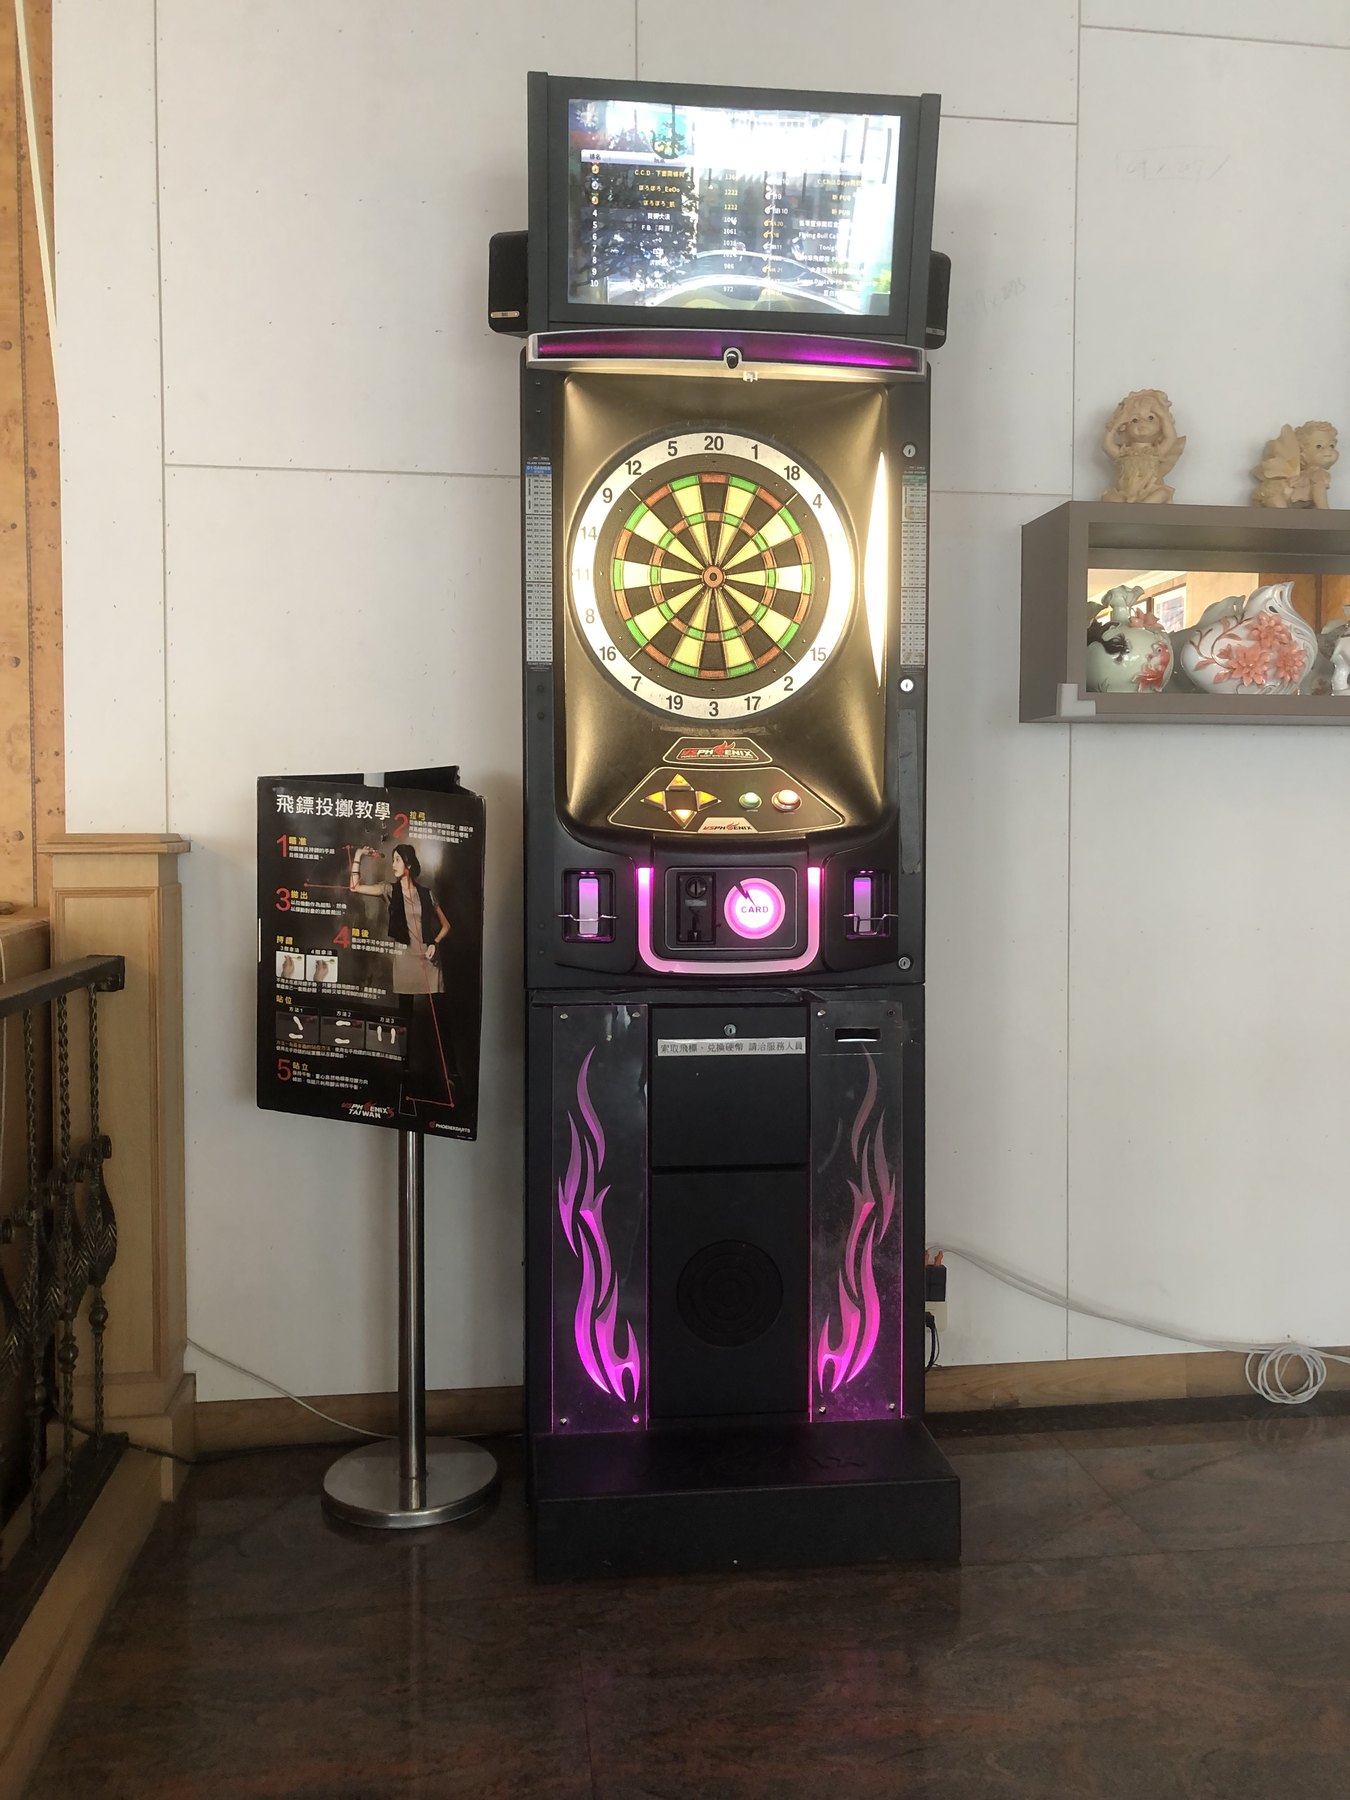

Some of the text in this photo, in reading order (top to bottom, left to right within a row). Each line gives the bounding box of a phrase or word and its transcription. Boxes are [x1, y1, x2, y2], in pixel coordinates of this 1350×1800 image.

[667, 441, 678, 457] 5
[704, 436, 724, 451] 20
[751, 445, 758, 460] 1
[625, 460, 642, 476] 12
[784, 465, 800, 481] 18
[602, 488, 613, 503] 9
[812, 494, 823, 508] 4
[581, 526, 597, 541] 14
[585, 609, 595, 624] 8
[599, 646, 616, 661] 16
[810, 647, 827, 661] 15
[631, 676, 642, 691] 7
[783, 676, 794, 691] 2
[666, 695, 684, 710] 19
[709, 701, 719, 716] 3
[744, 695, 762, 711] 17
[276, 794, 391, 820] 飛鏢投擲教學
[392, 813, 408, 838] 2
[276, 834, 288, 858] 1
[275, 887, 291, 912] 3
[741, 905, 769, 913] CARD
[333, 926, 350, 949] 4
[276, 1058, 292, 1081] 5
[348, 1109, 381, 1119] TAIWAN
